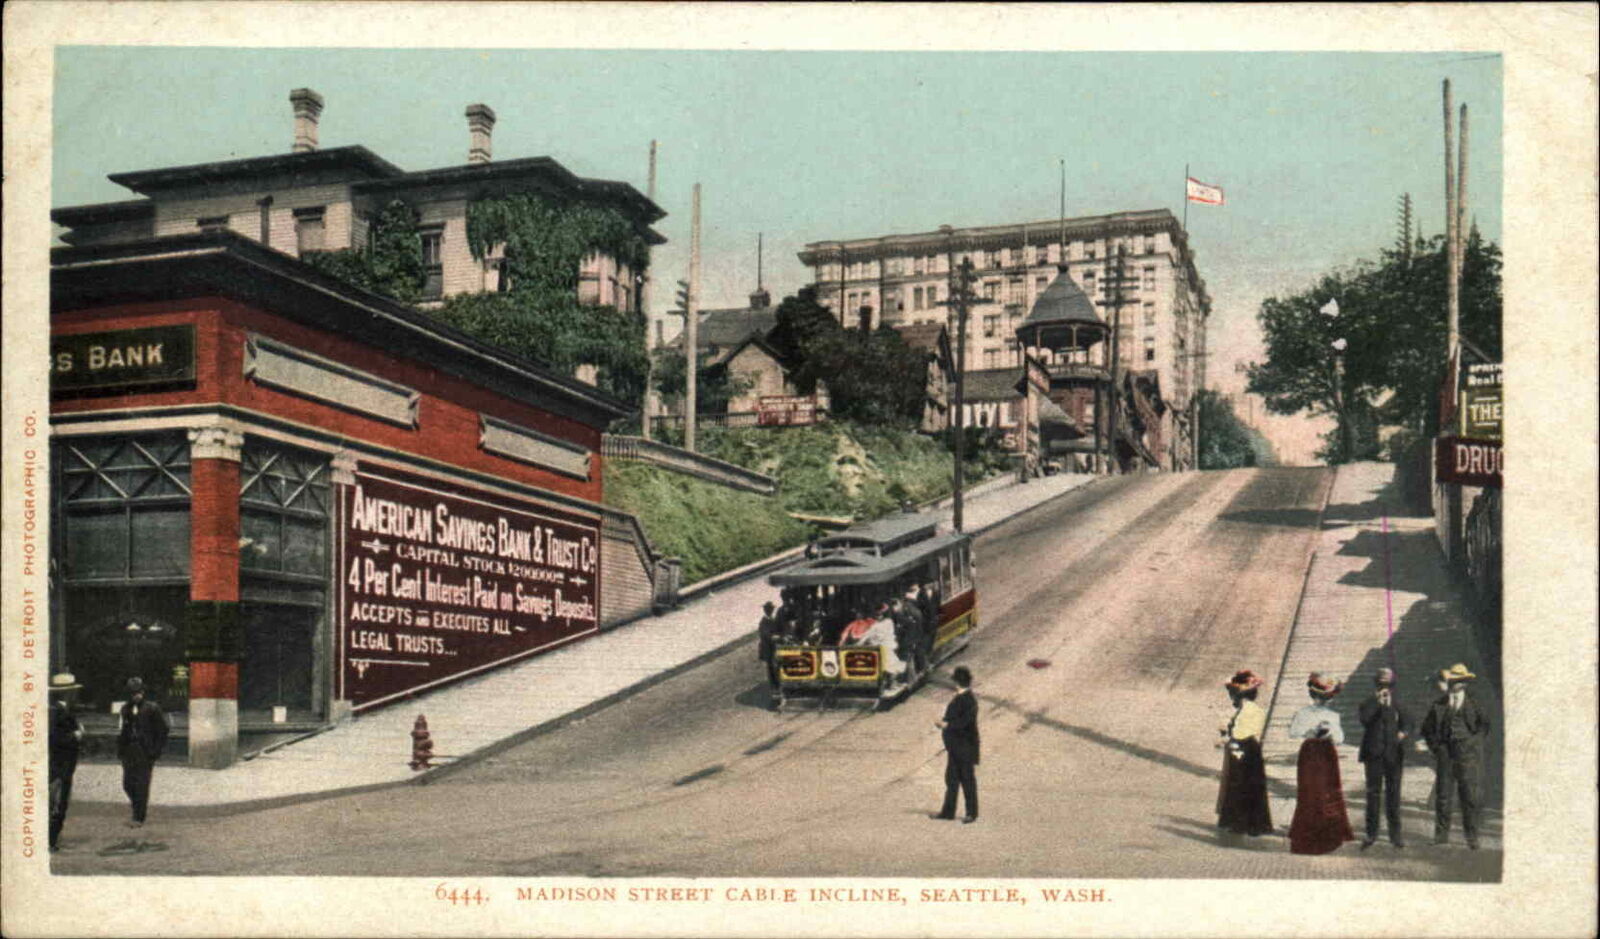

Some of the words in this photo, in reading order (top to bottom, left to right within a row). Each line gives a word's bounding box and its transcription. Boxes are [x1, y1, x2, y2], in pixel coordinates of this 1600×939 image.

[50, 353, 73, 372] S
[88, 343, 163, 370] BANK
[1469, 403, 1502, 422] THE
[351, 484, 432, 543] AMERICAN
[436, 503, 496, 554] SAVINGS
[498, 517, 531, 561] BANK
[533, 526, 544, 564] &
[545, 528, 579, 570] TRUST
[396, 542, 460, 568] CAPITAL
[463, 556, 505, 575] STOCK
[348, 556, 361, 593] 4
[364, 558, 389, 596] Per
[392, 563, 422, 600] Cent
[425, 567, 471, 606] Interest
[474, 575, 498, 610] Paid
[501, 591, 513, 611] on
[516, 582, 552, 622] Savings
[350, 603, 413, 626] ACCEPTS
[433, 611, 489, 634] EXECUTES
[493, 619, 512, 635] ALL
[351, 630, 393, 651] LEGAL
